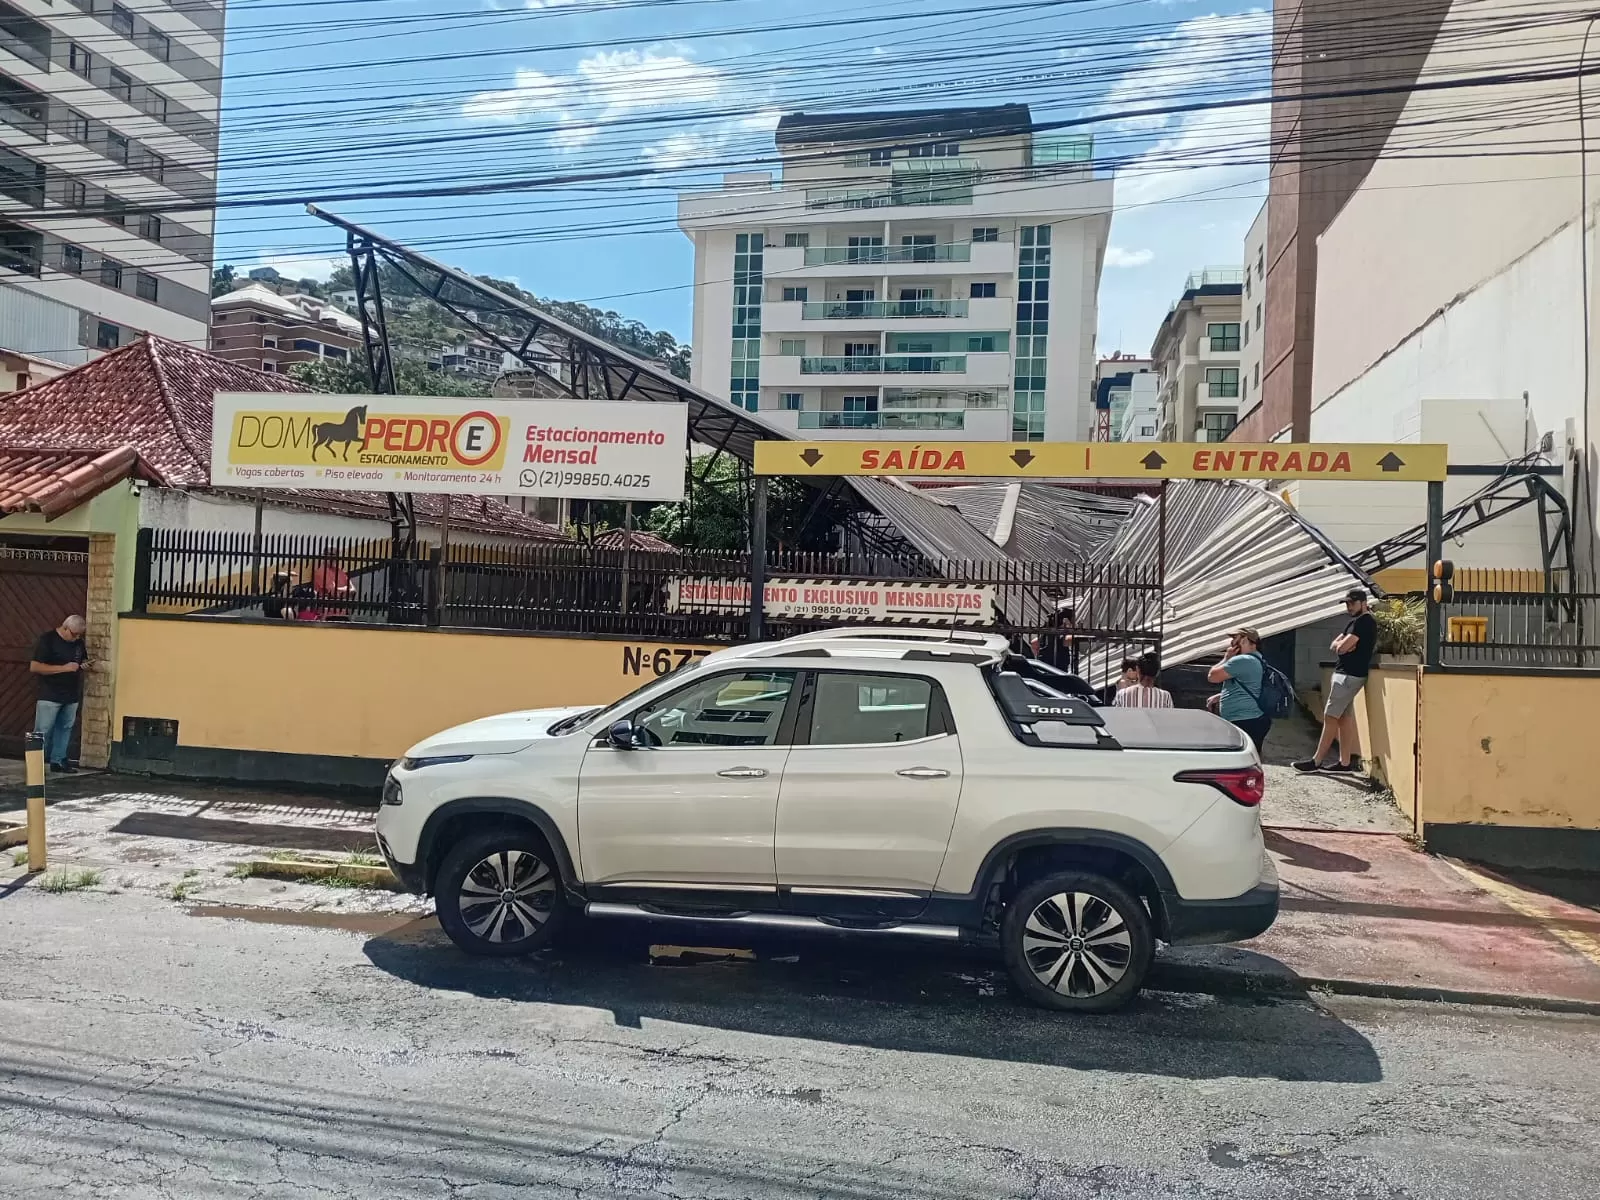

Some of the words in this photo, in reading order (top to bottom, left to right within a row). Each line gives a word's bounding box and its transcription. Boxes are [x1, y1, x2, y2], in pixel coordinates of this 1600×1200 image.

[237, 415, 312, 449] DOM
[525, 425, 665, 445] Estacionamento
[359, 453, 449, 466] ESTACIONAMENTO
[523, 445, 597, 464] Mensal
[860, 445, 967, 470] SAÍDA
[1192, 450, 1353, 473] ENTRADA
[235, 466, 264, 478] Vagas
[264, 467, 305, 478] cobertas
[325, 468, 347, 478] Piso
[346, 469, 384, 480] elevado
[404, 471, 477, 483] Monitoramento
[480, 473, 493, 483] 24
[539, 470, 651, 488] (21)99850.4025
[680, 584, 797, 604] ESTACIONAENTO
[803, 589, 879, 606] EXCLUSIVO
[885, 591, 982, 609] MENSALISTAS
[794, 606, 809, 614] (21)
[811, 605, 870, 616] 99850-4025
[1027, 705, 1073, 714] TORO
